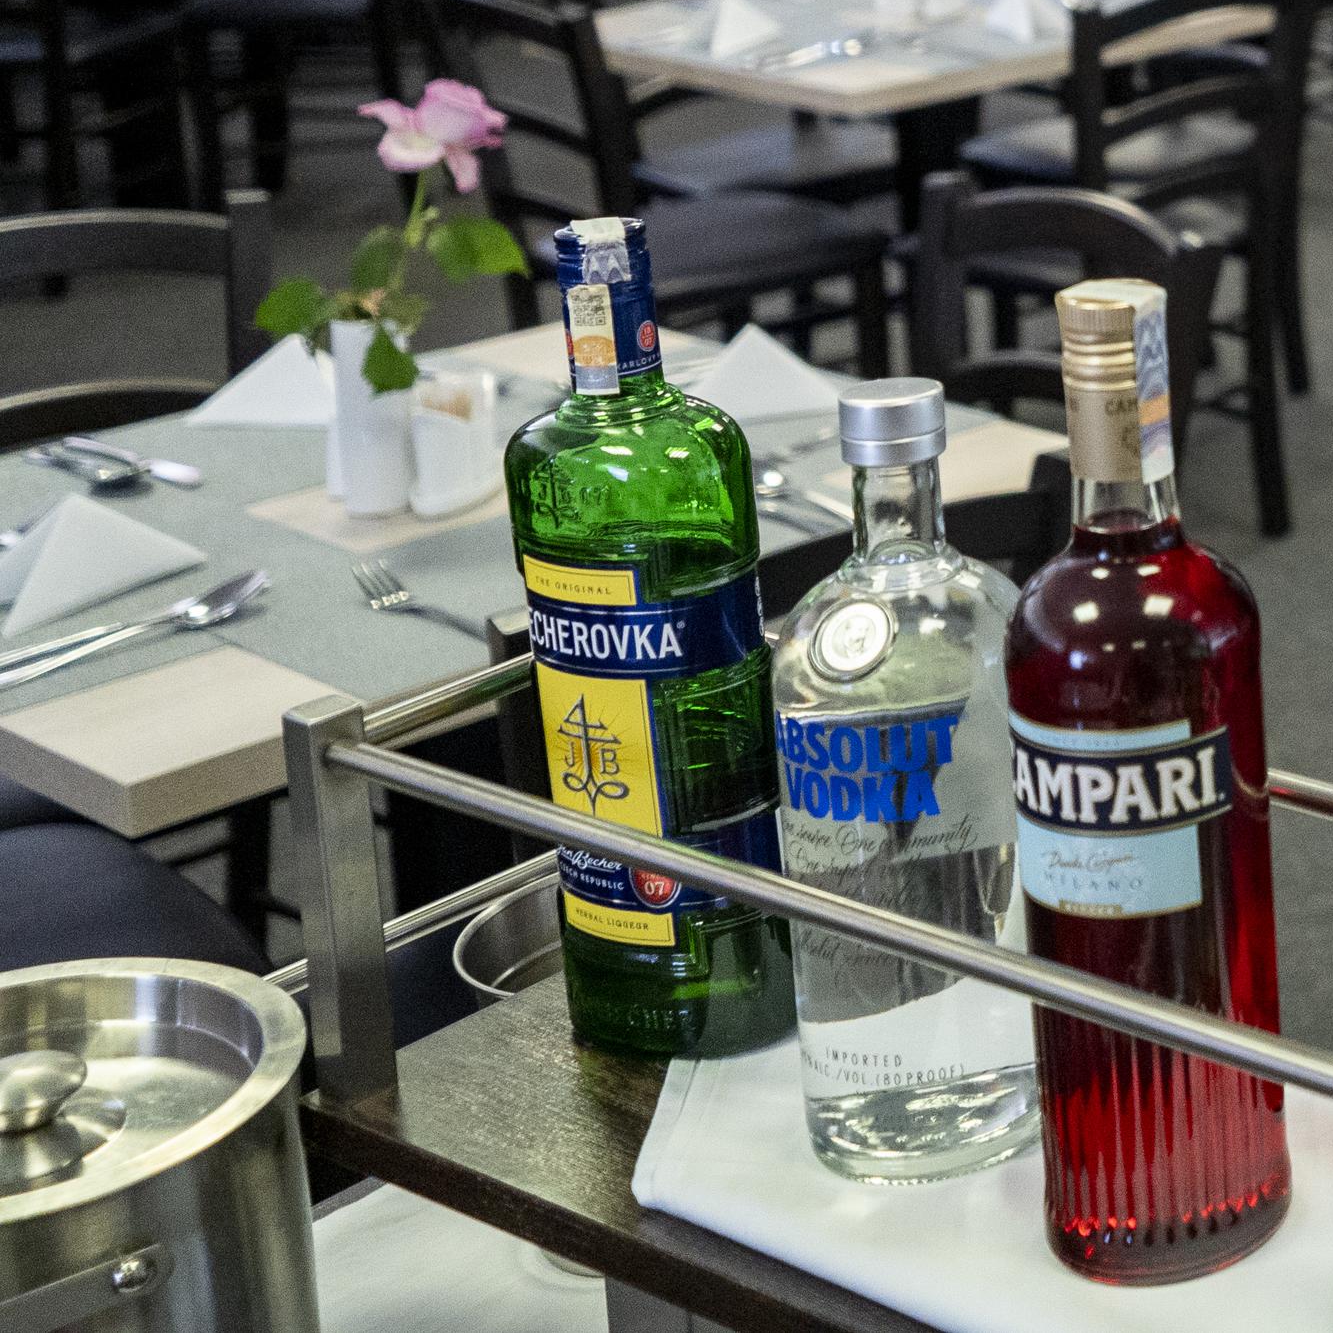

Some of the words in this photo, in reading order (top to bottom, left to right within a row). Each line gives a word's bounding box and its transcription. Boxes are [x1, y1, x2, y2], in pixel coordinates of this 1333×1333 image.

[535, 575, 550, 587] THE
[554, 580, 612, 596] ORIGINAL
[529, 607, 683, 660] ECHEROVKA
[776, 709, 958, 773] ABSOLUT
[785, 762, 941, 824] VODKA
[1015, 745, 1217, 825] AMPARI
[570, 850, 624, 871] Becher
[580, 873, 625, 892] REPUBLIC
[644, 880, 665, 896] 07
[825, 1046, 903, 1067] IMPORTED
